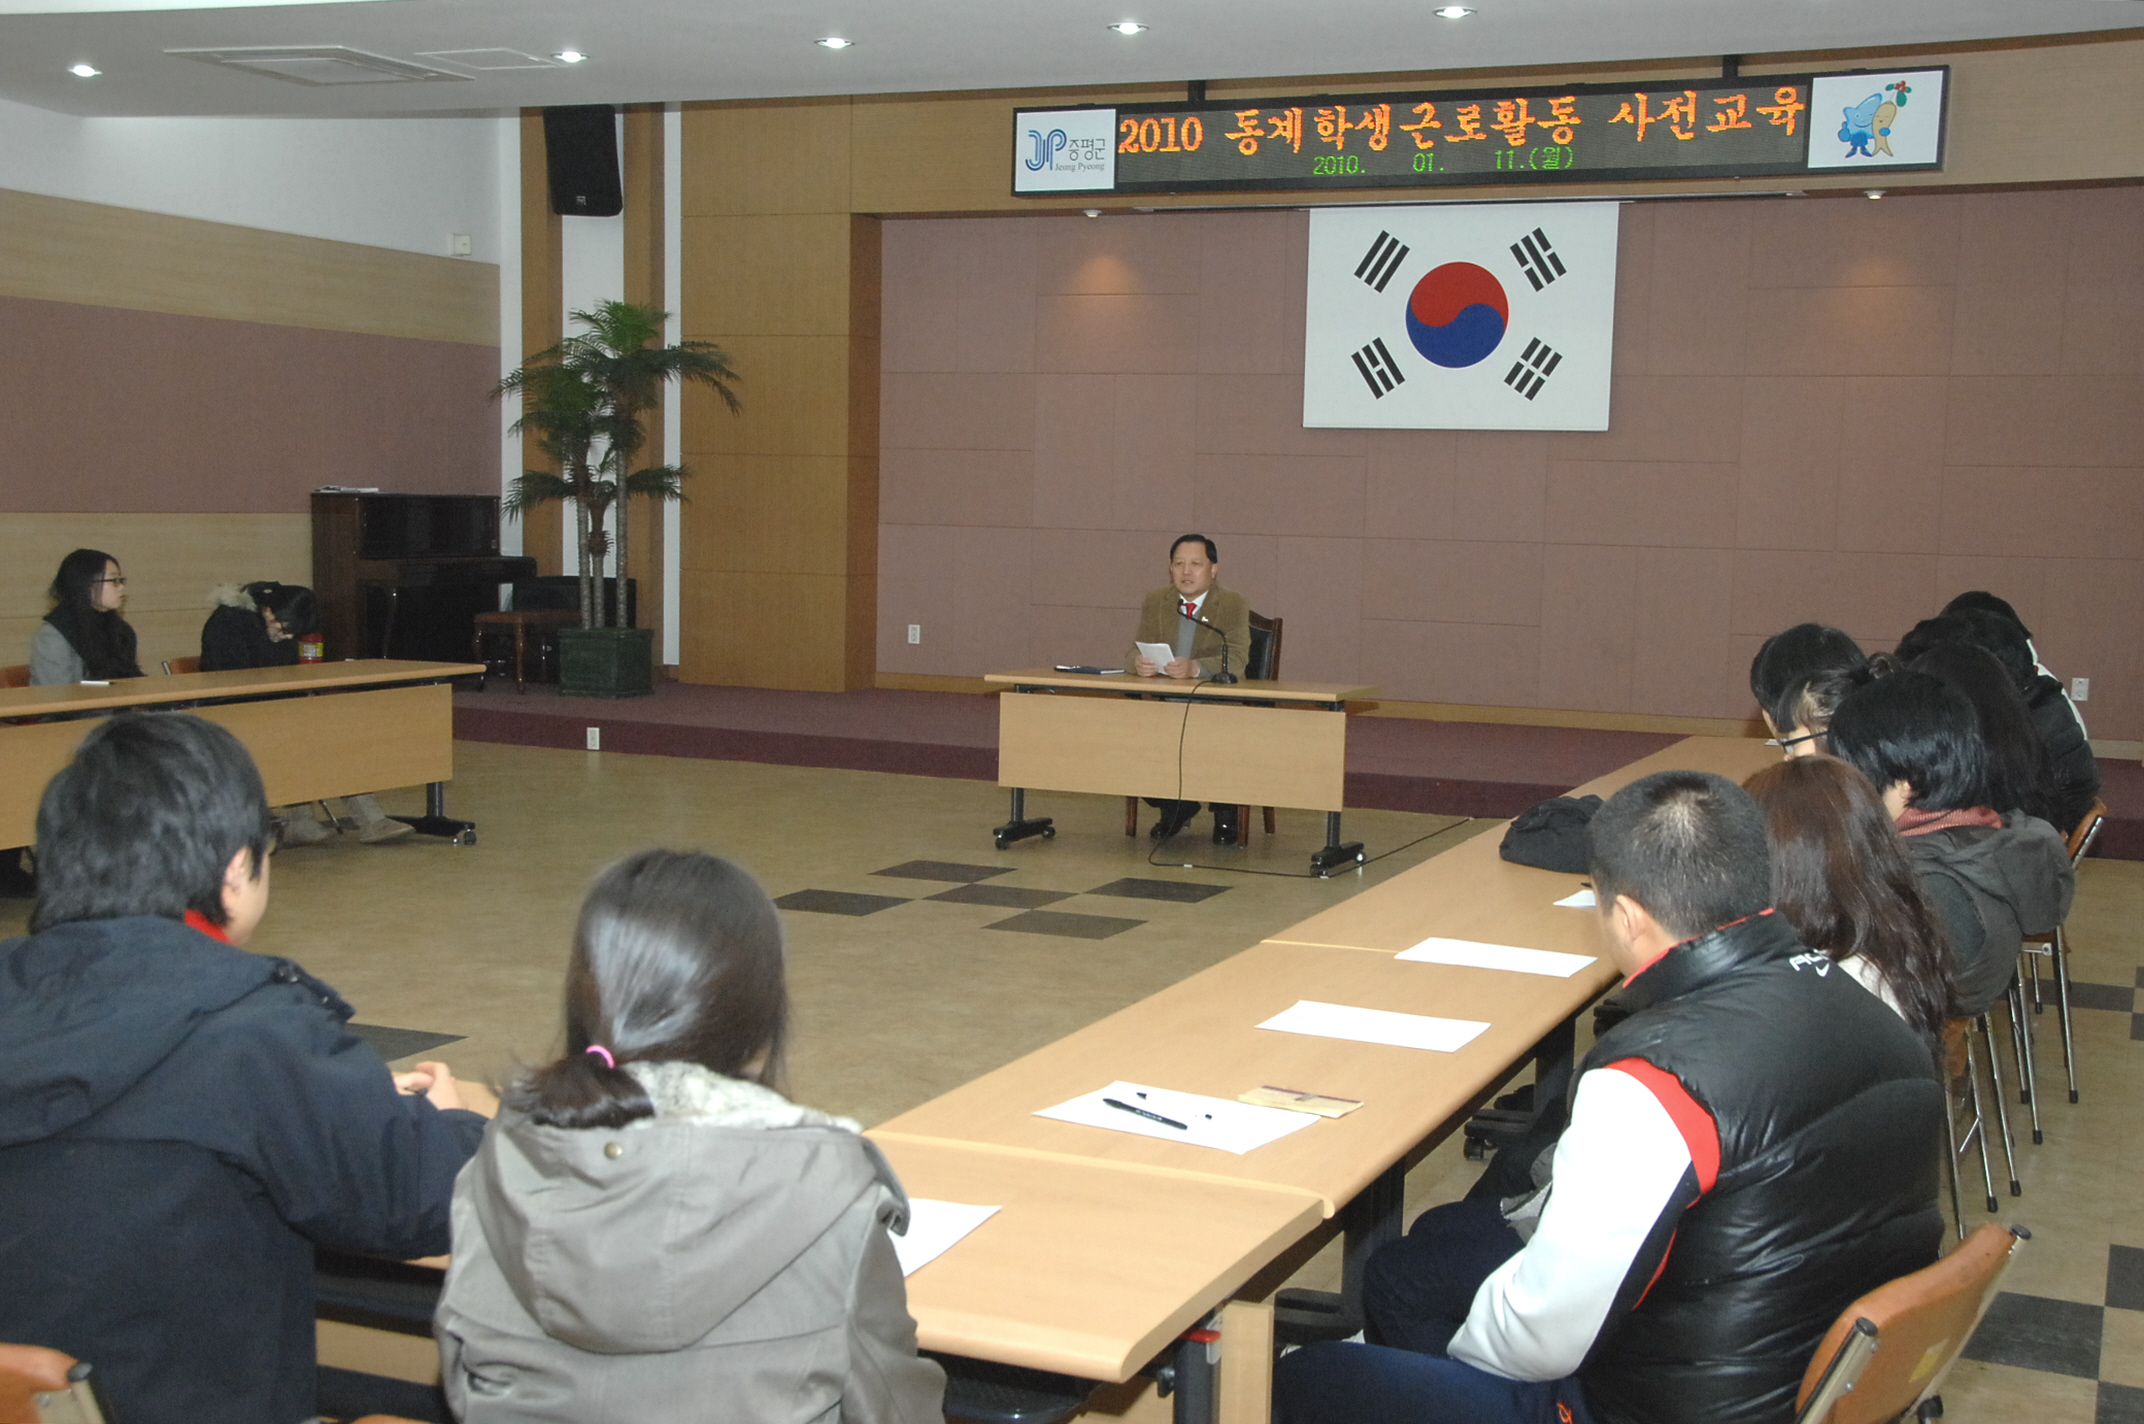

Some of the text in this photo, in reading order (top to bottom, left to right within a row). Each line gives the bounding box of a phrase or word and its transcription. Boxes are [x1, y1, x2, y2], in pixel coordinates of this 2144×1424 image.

[1118, 116, 1203, 154] 2010
[1068, 138, 1106, 162] 증평군
[1313, 154, 1366, 175] 2010.
[1412, 152, 1445, 172] 01.
